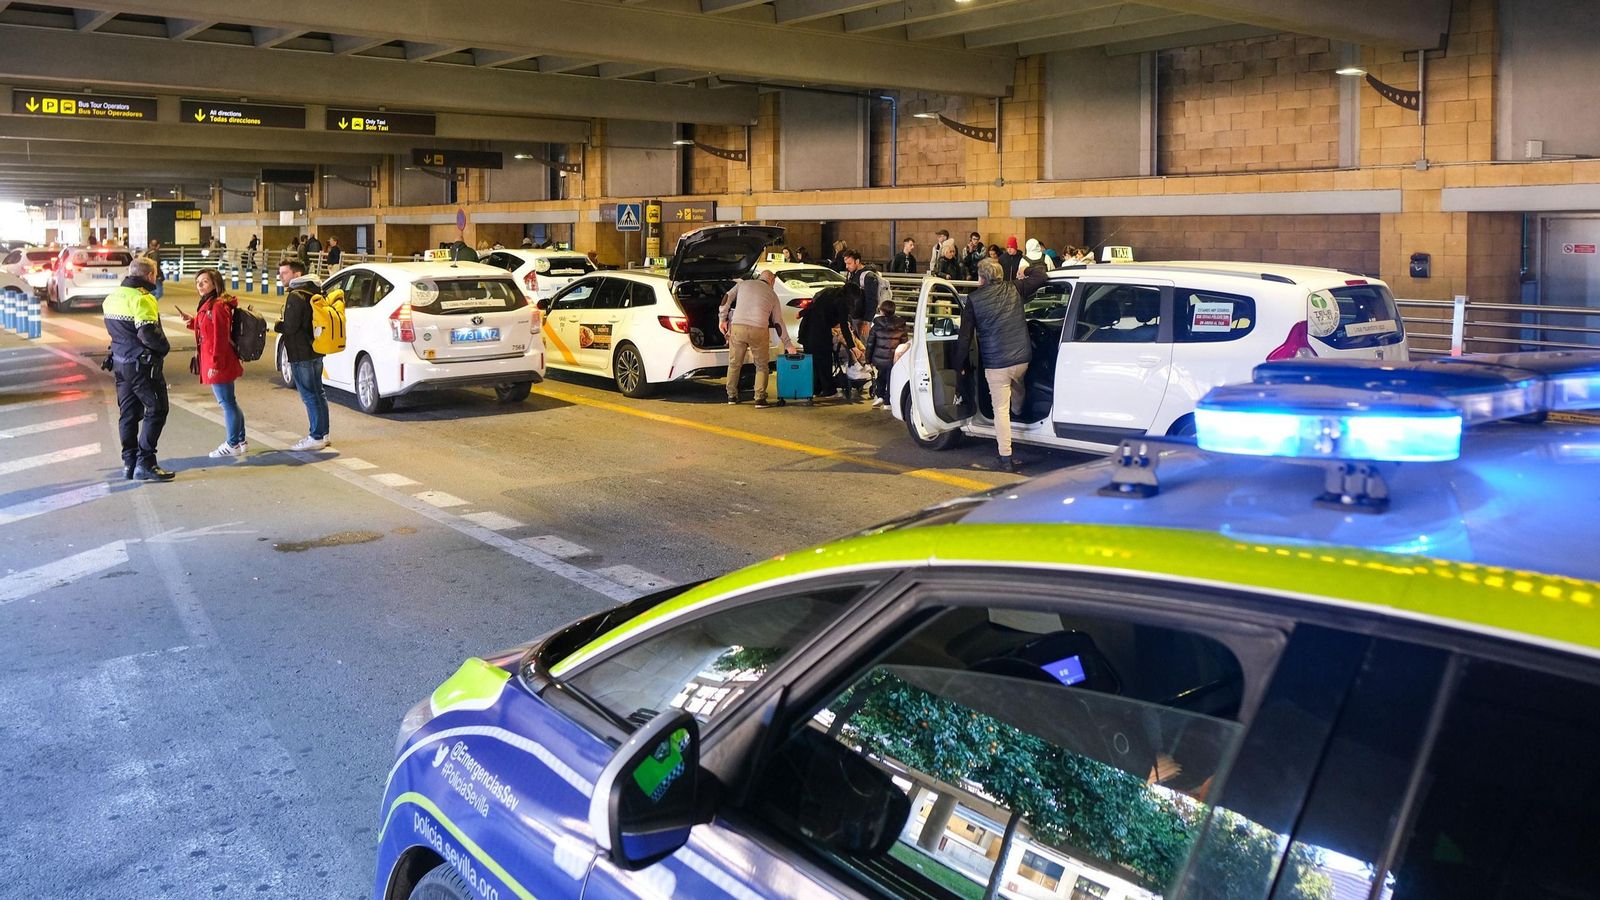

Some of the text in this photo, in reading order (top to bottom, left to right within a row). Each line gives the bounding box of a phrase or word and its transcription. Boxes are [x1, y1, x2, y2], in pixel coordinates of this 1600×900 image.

[90, 101, 102, 109] Tour
[107, 110, 143, 118] Operadores
[229, 117, 261, 125] direcciones
[450, 741, 519, 812] @EmergenciasSev
[441, 760, 489, 818] #PoliciaSevilla
